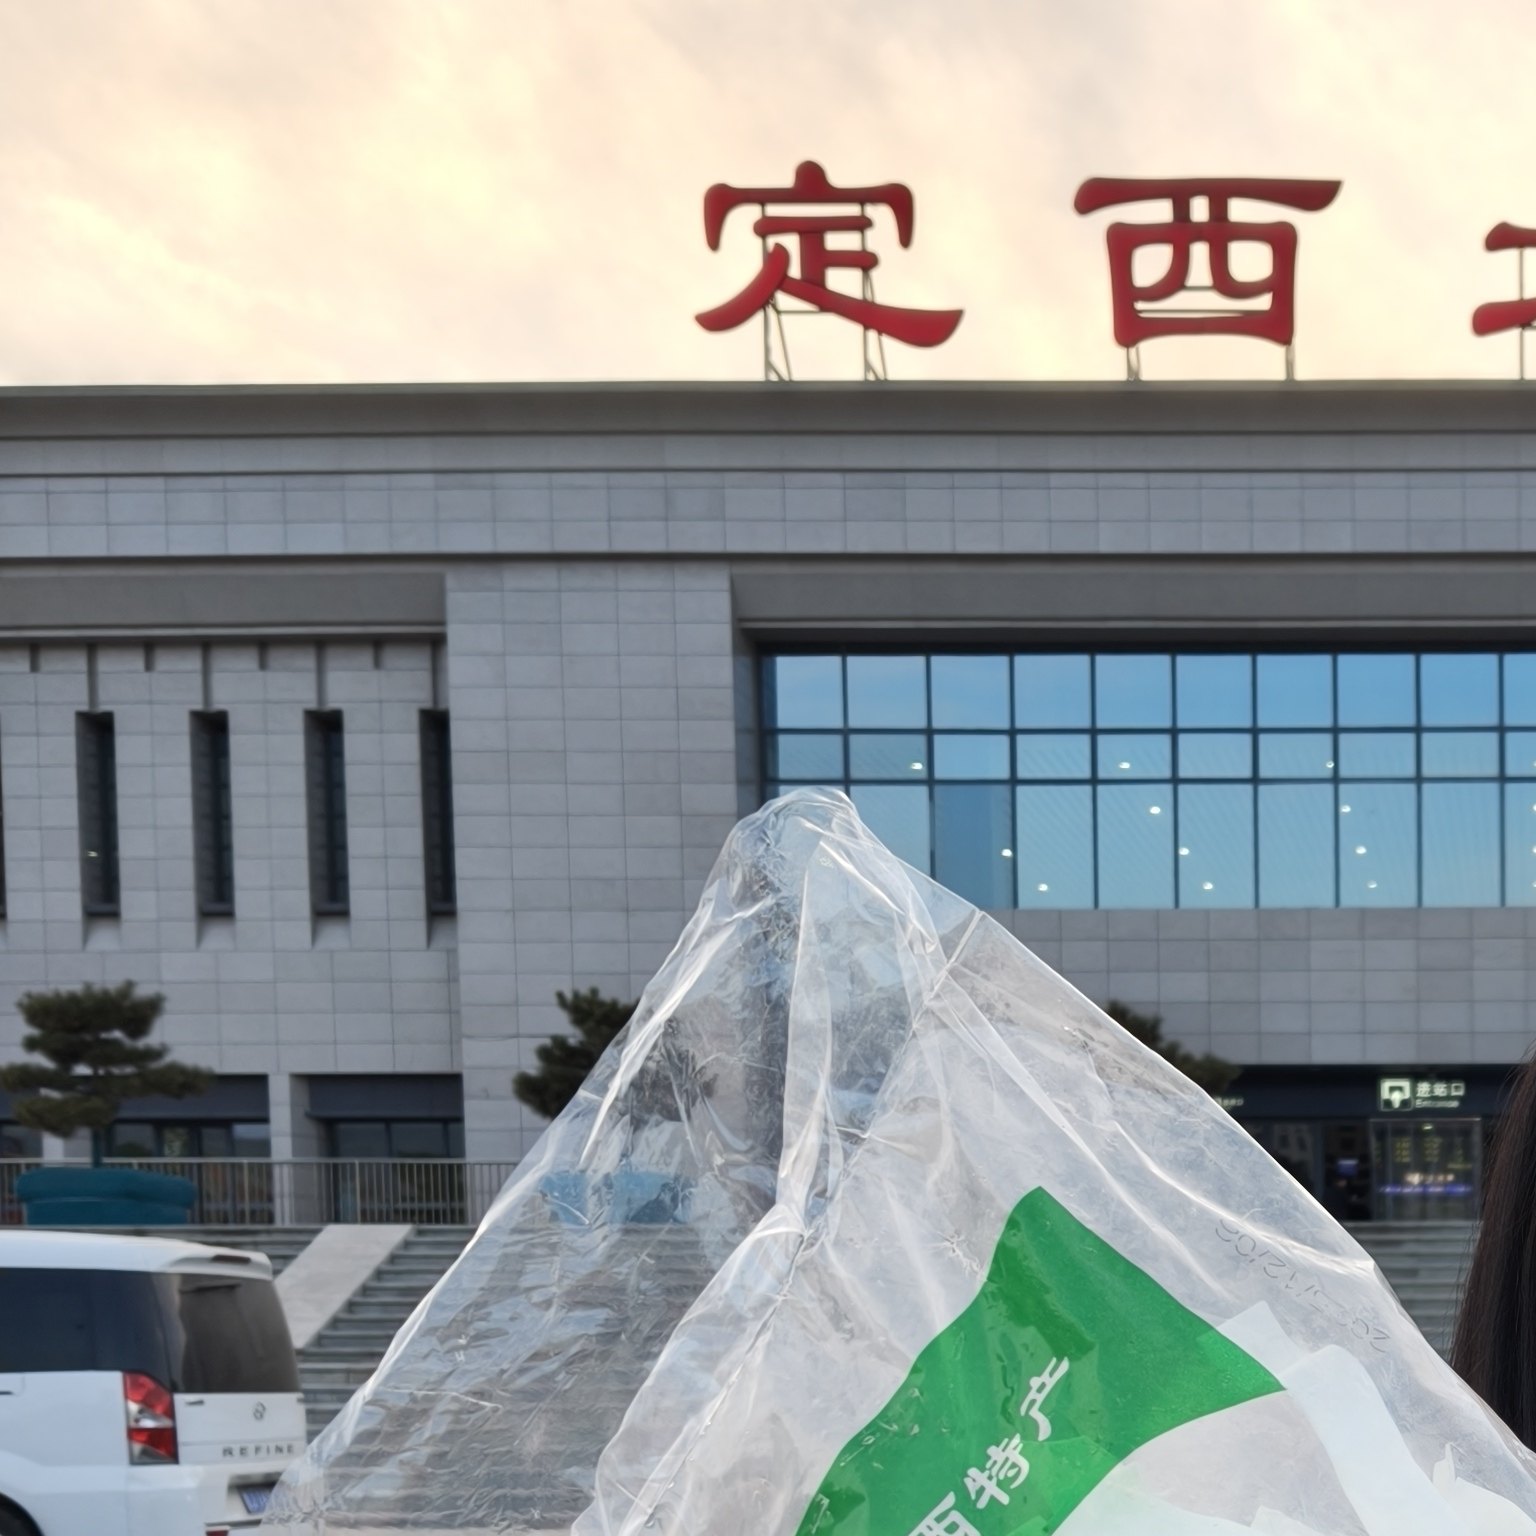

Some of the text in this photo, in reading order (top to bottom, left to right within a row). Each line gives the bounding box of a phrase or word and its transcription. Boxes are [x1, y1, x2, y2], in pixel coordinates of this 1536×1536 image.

[1415, 1081, 1465, 1097] 进站口
[222, 1444, 295, 1457] REFINE
